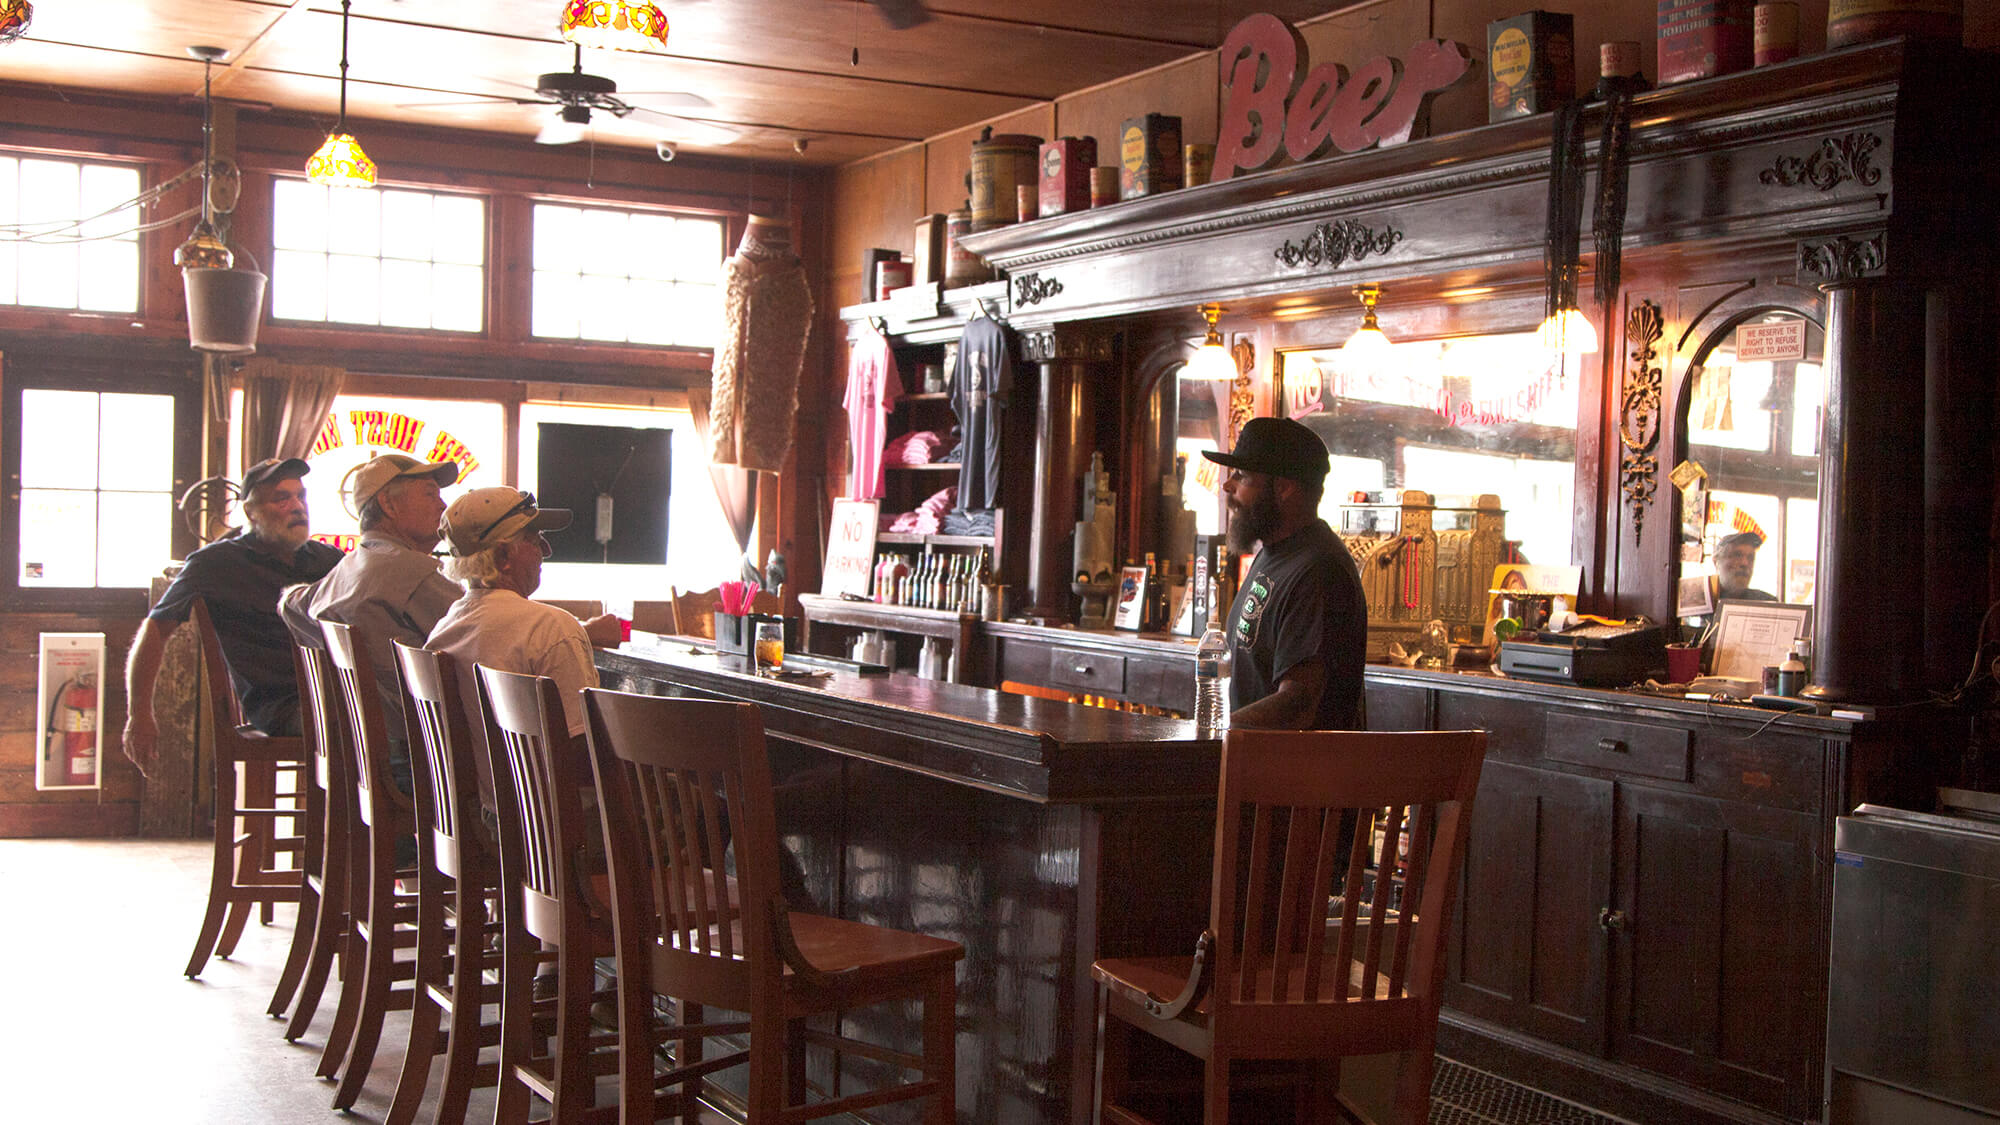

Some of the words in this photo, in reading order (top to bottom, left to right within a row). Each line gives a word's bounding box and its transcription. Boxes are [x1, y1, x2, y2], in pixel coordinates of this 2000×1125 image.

[1210, 12, 1471, 183] Beer
[1746, 329, 1756, 338] WE
[1758, 327, 1784, 337] RESERVE
[1786, 326, 1798, 335] THE
[1746, 338, 1763, 347] RIGHT
[1775, 335, 1797, 344] REFUSE
[1741, 347, 1764, 356] SERVICE
[1767, 346, 1775, 354] TO
[1776, 344, 1800, 354] ANYONE
[1286, 367, 1324, 413] NO
[843, 521, 862, 542] NO
[1542, 575, 1560, 587] THE
